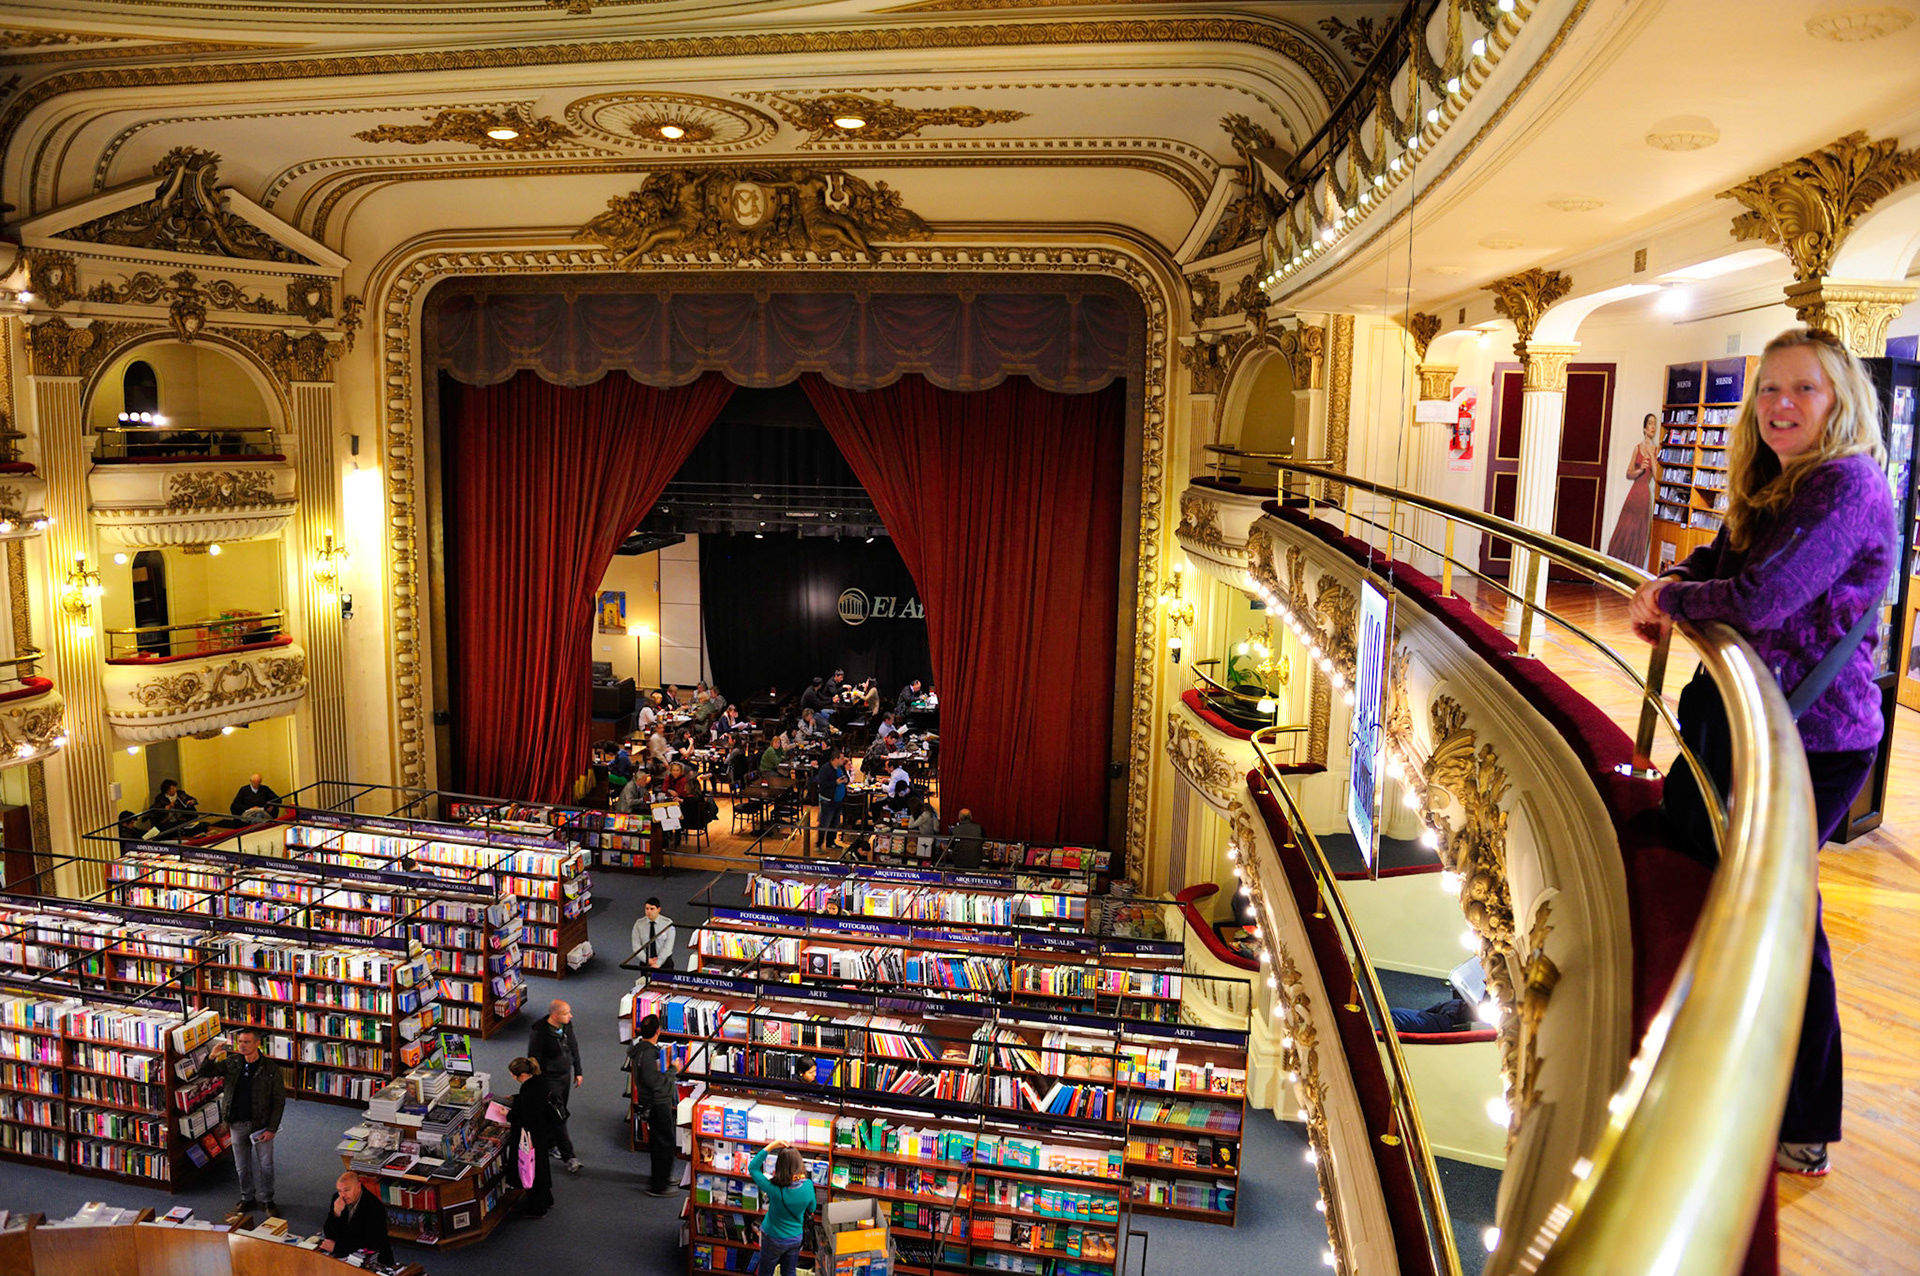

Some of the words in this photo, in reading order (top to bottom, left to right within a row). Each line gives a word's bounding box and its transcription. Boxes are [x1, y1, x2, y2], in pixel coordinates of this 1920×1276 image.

[870, 596, 897, 618] El
[194, 852, 227, 861] ASTROLOGIA
[265, 861, 299, 870] ESOTERISMO
[784, 863, 831, 872] ARQUITECTURA
[348, 872, 382, 881] OCULTISMO
[873, 870, 921, 879] ARQUITECTURA
[954, 876, 1002, 886] ARQUITECTURA
[152, 917, 183, 926] FILOSOFIA
[739, 912, 780, 922] FOTOGRAFIA
[244, 926, 277, 935] FILOSOFIA
[838, 921, 880, 932] FOTOGRAFIA
[341, 937, 374, 945] FILOSOFIA
[948, 934, 980, 942] VISUALES
[1043, 938, 1075, 947] VISUALES
[673, 974, 691, 983] ARTE
[691, 976, 733, 988] ARGENTINO
[808, 990, 828, 998] ARTE
[925, 1001, 946, 1011] ARTE
[1048, 1013, 1068, 1022] ARTE
[1174, 1028, 1196, 1038] ARTE
